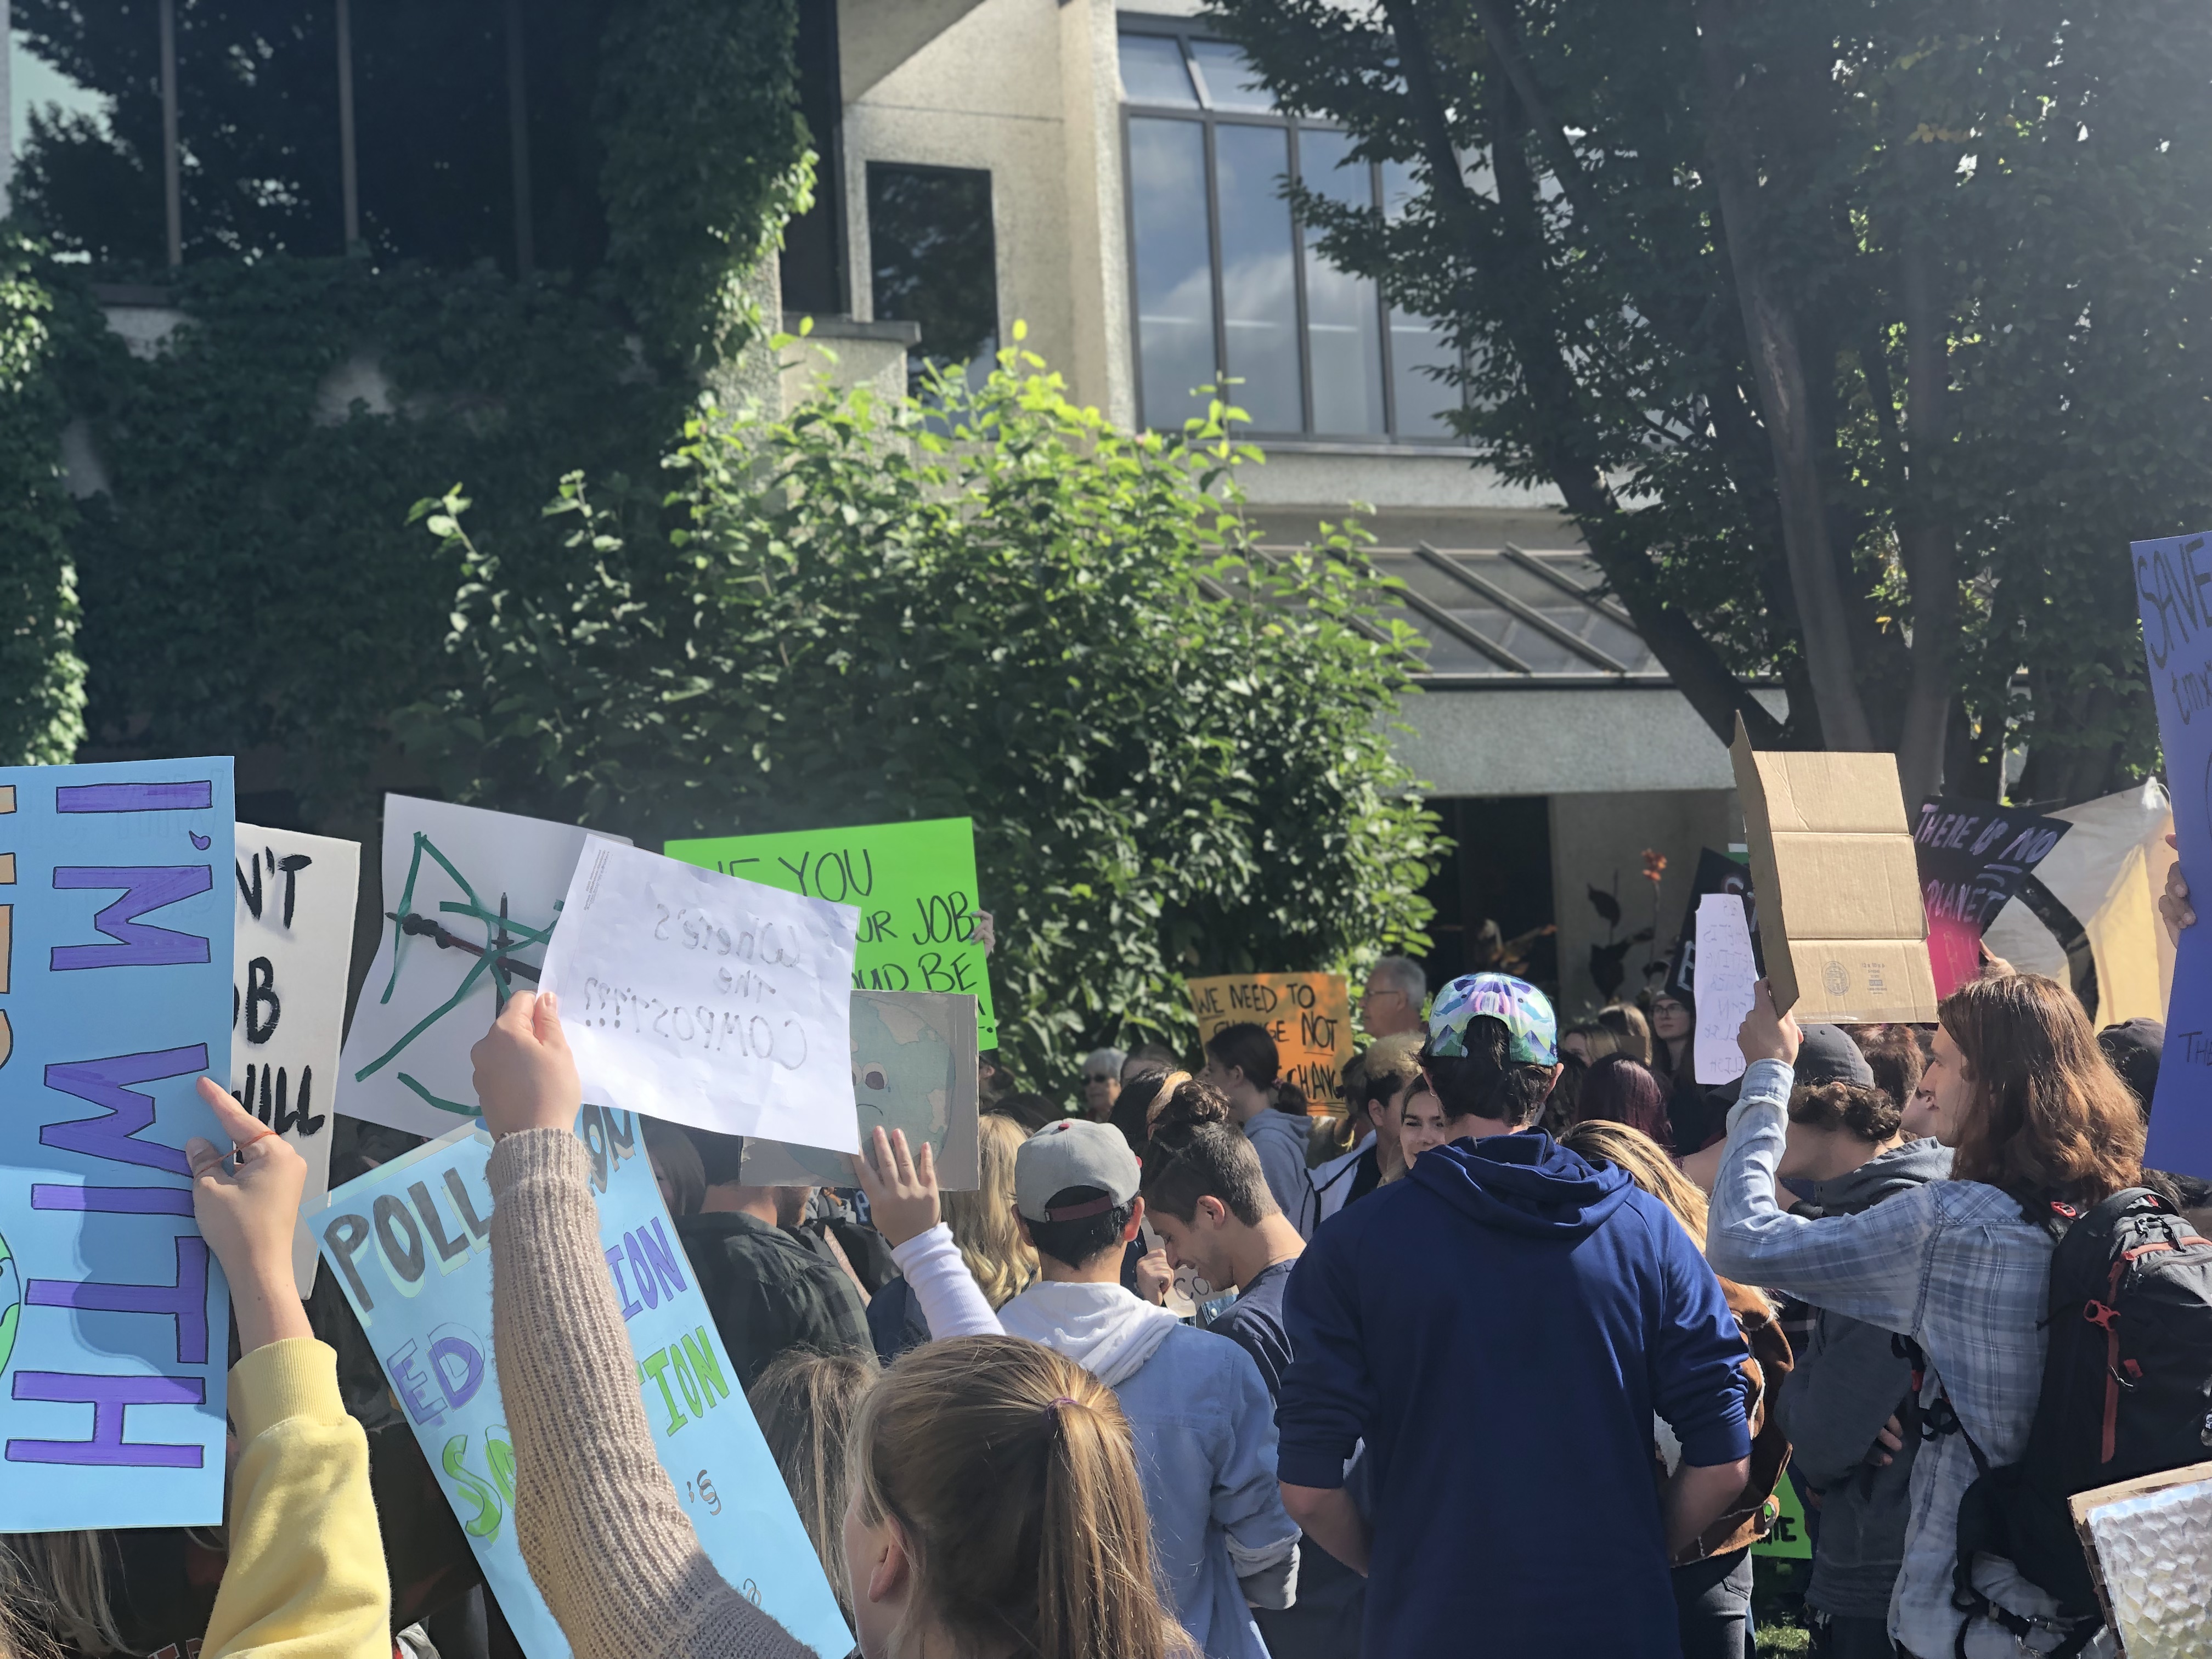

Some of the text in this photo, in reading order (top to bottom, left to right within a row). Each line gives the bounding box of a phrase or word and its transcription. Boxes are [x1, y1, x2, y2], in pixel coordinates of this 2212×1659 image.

[1914, 803, 1979, 849] THERE
[1998, 827, 2057, 863] NO
[777, 849, 872, 902] YOU
[912, 891, 975, 945] JOB
[1927, 879, 2006, 924] PLANET
[918, 952, 978, 992] BE
[1192, 983, 1315, 1014] WE NEED TO
[1301, 1011, 1338, 1052] NOT
[5, 780, 212, 1468] I'M WITH
